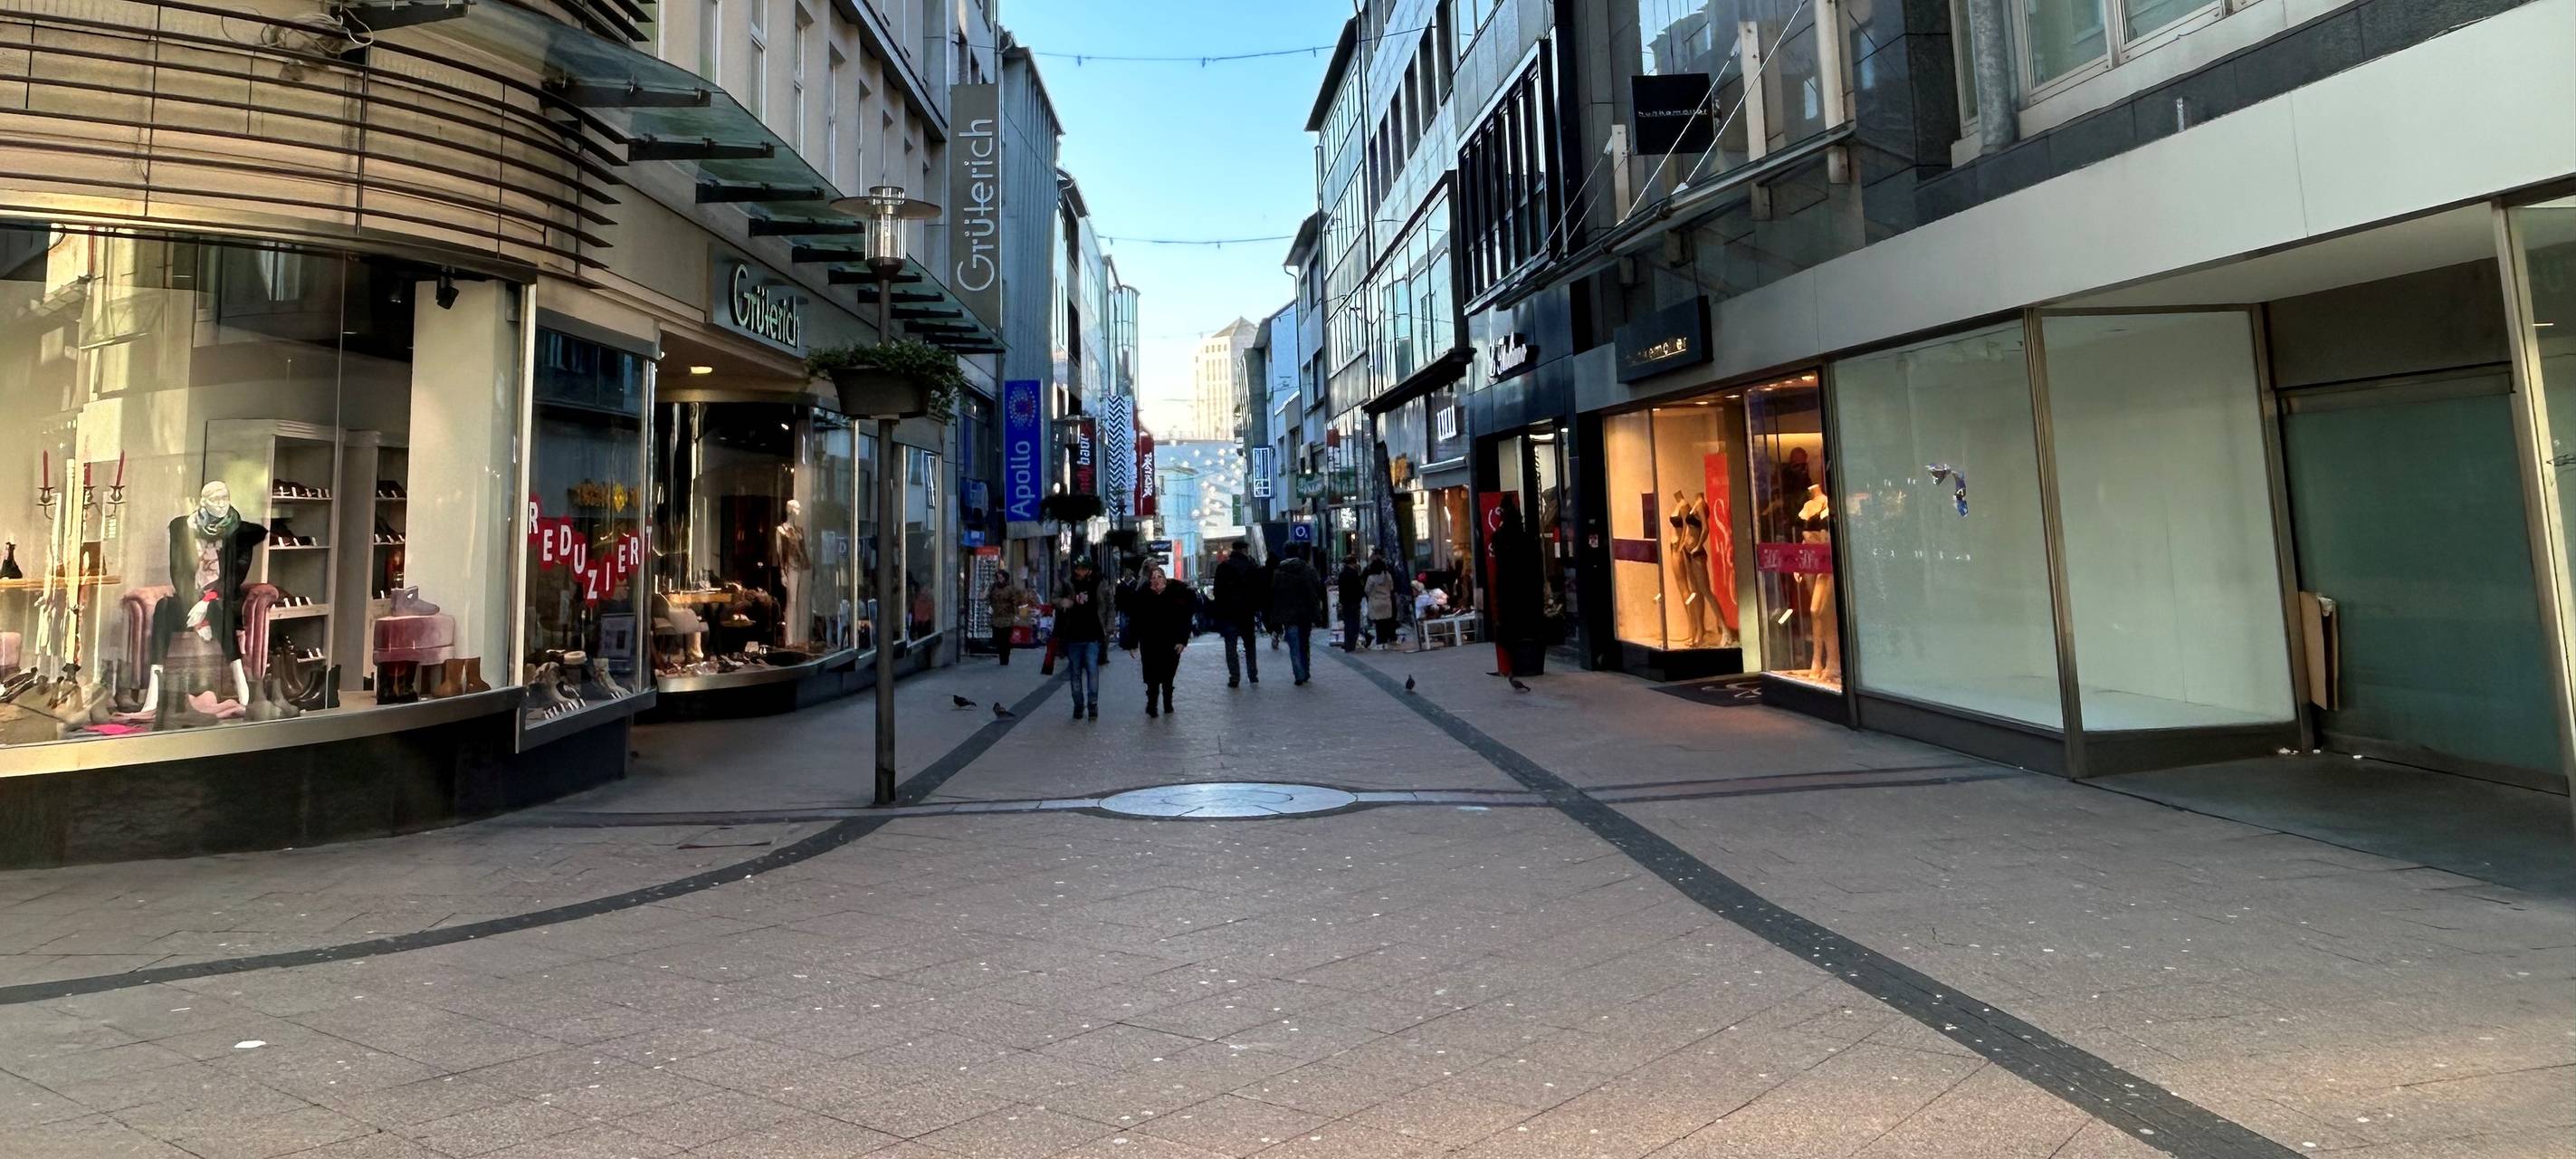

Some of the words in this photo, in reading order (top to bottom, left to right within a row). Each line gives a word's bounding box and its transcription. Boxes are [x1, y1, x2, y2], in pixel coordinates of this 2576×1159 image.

[957, 119, 995, 292] Grüterich
[734, 263, 800, 349] Grüterich
[1010, 440, 1035, 518] Apollo
